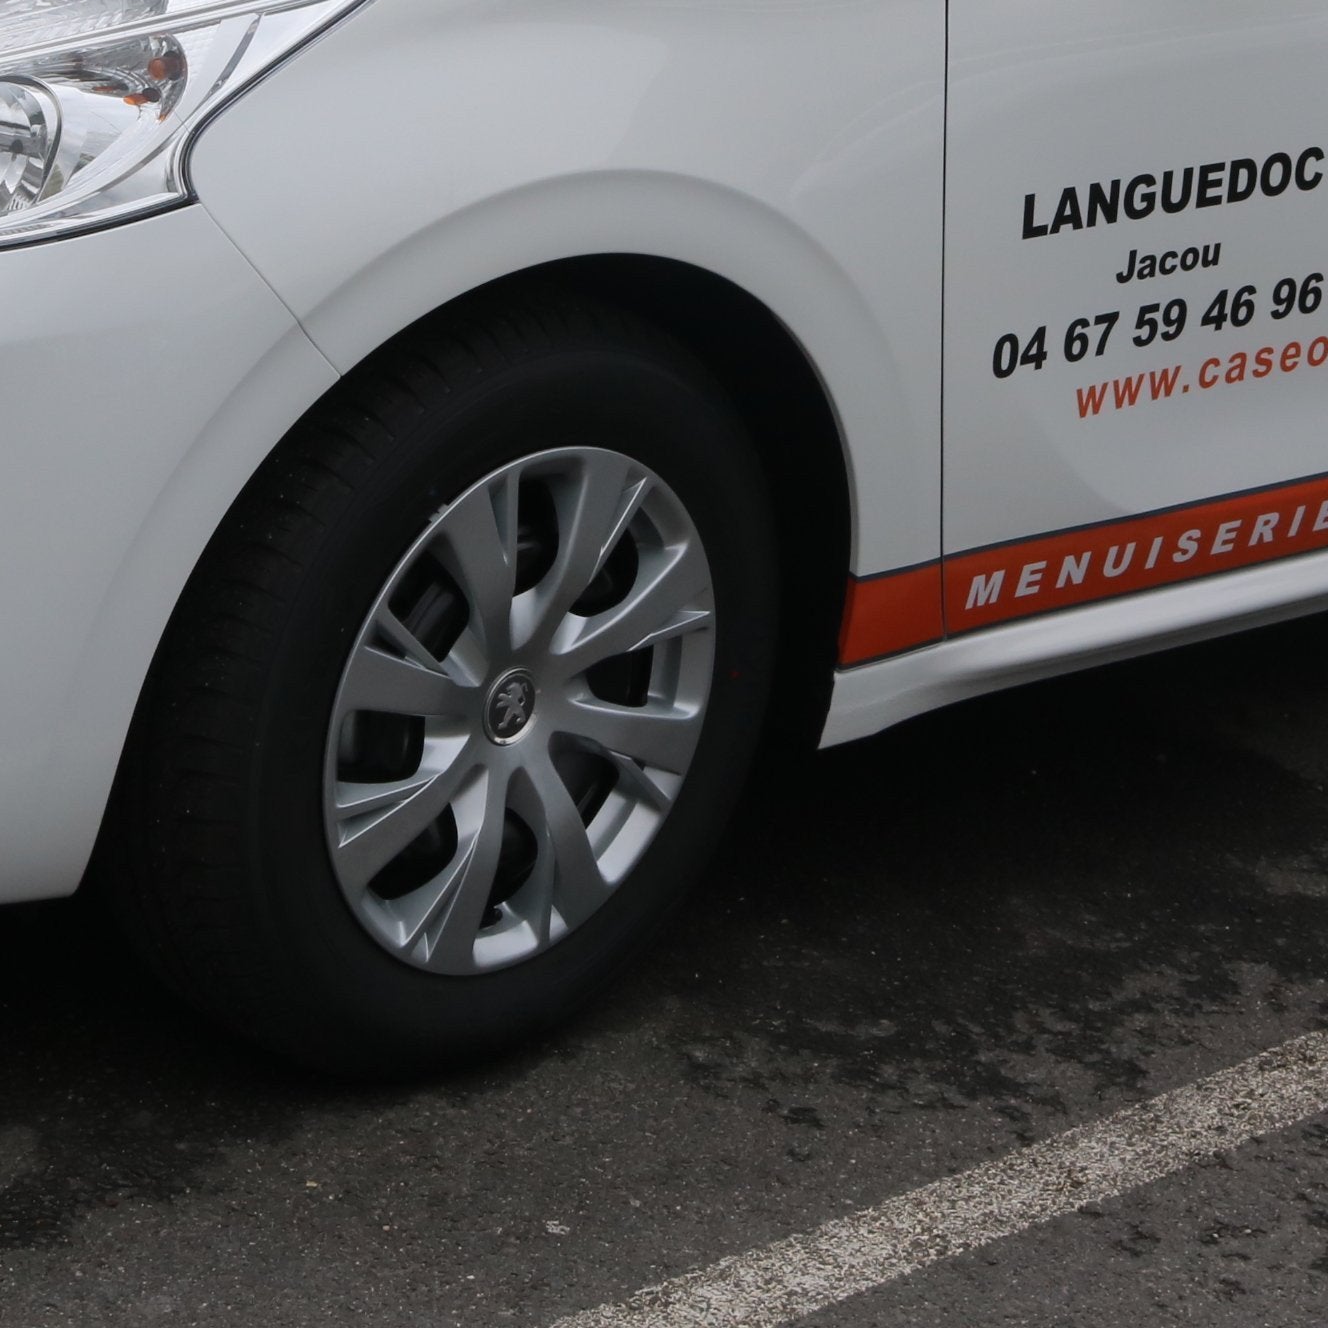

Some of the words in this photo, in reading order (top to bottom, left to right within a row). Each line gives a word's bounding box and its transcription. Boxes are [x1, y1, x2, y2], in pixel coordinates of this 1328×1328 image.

[1022, 146, 1325, 240] LANGUEDOC
[1115, 242, 1221, 284] Jacou
[992, 325, 1048, 379] 04
[1063, 310, 1120, 363] 67
[1132, 298, 1188, 347] 59
[1200, 285, 1257, 331] 46
[1270, 272, 1324, 320] 96
